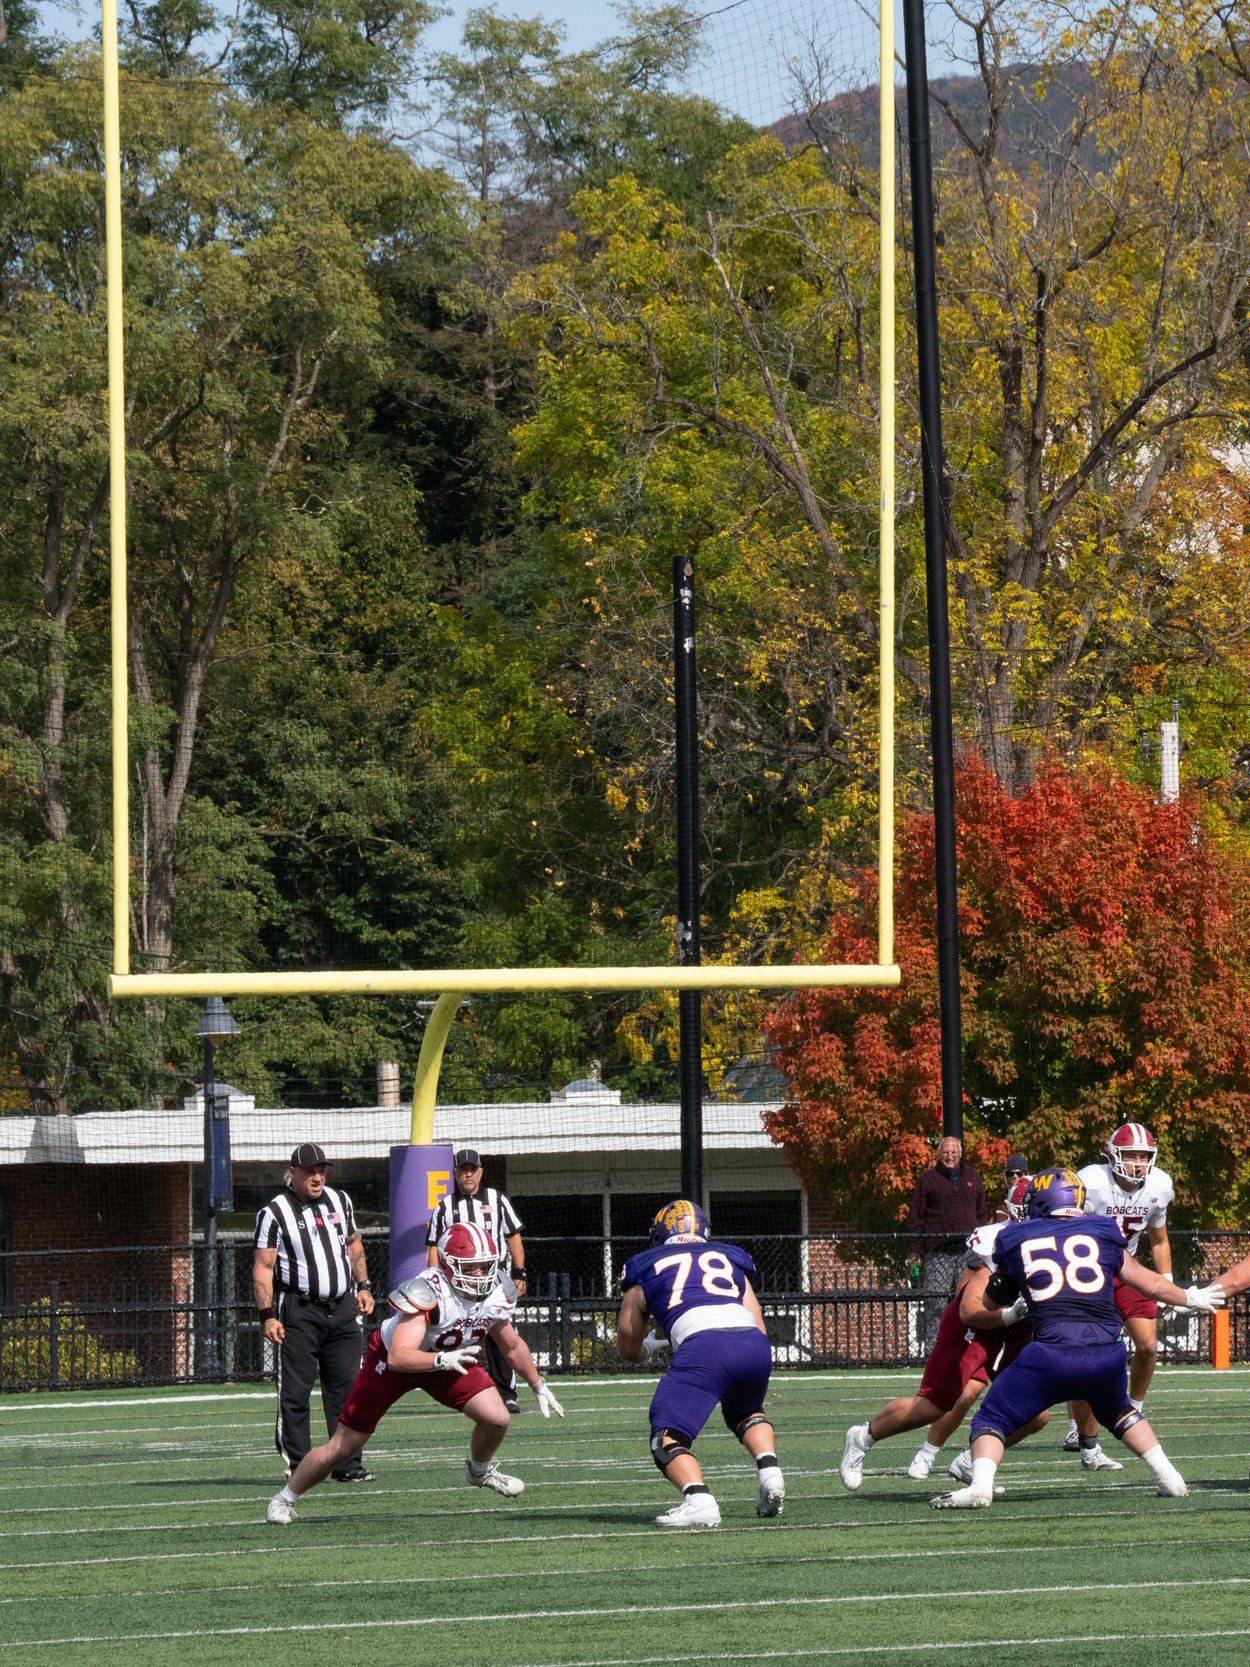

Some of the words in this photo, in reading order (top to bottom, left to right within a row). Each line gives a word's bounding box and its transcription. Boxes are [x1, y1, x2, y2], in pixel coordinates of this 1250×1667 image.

[426, 1171, 450, 1210] E
[1034, 1174, 1054, 1192] W
[1106, 1206, 1149, 1216] BOBCATS
[298, 1220, 306, 1229] S
[486, 1221, 492, 1230] B
[1020, 1234, 1105, 1302] 58
[654, 1249, 740, 1310] 78
[453, 1317, 491, 1329] BOBCATS
